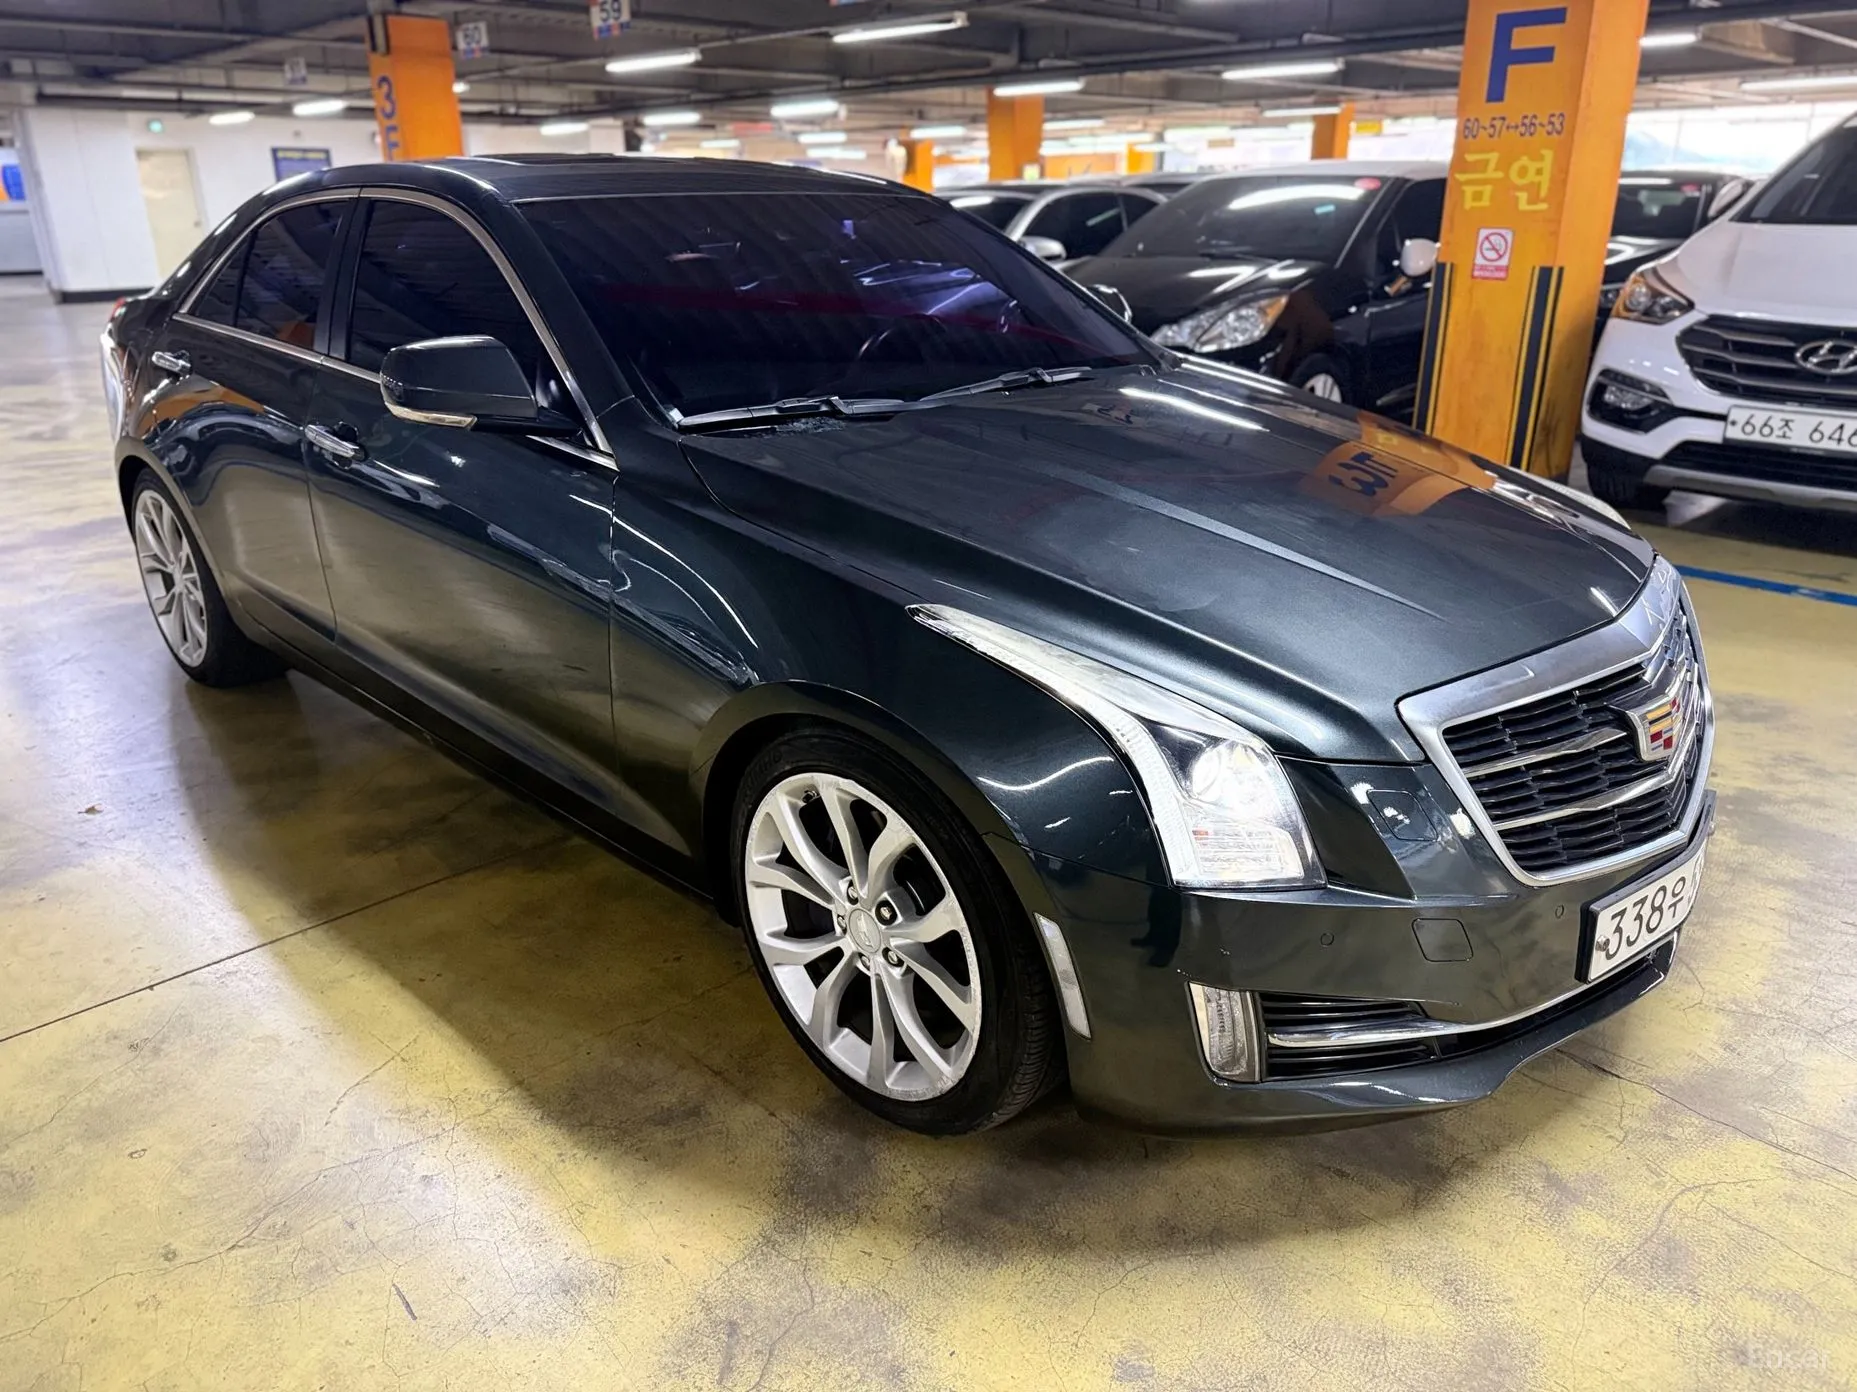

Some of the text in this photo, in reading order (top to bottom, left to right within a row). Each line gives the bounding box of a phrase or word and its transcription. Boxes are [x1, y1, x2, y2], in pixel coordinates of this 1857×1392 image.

[599, 0, 622, 22] 59
[462, 25, 482, 46] 60
[1485, 7, 1568, 104] F
[1454, 147, 1555, 212] 금연
[1741, 413, 1796, 441] 66조
